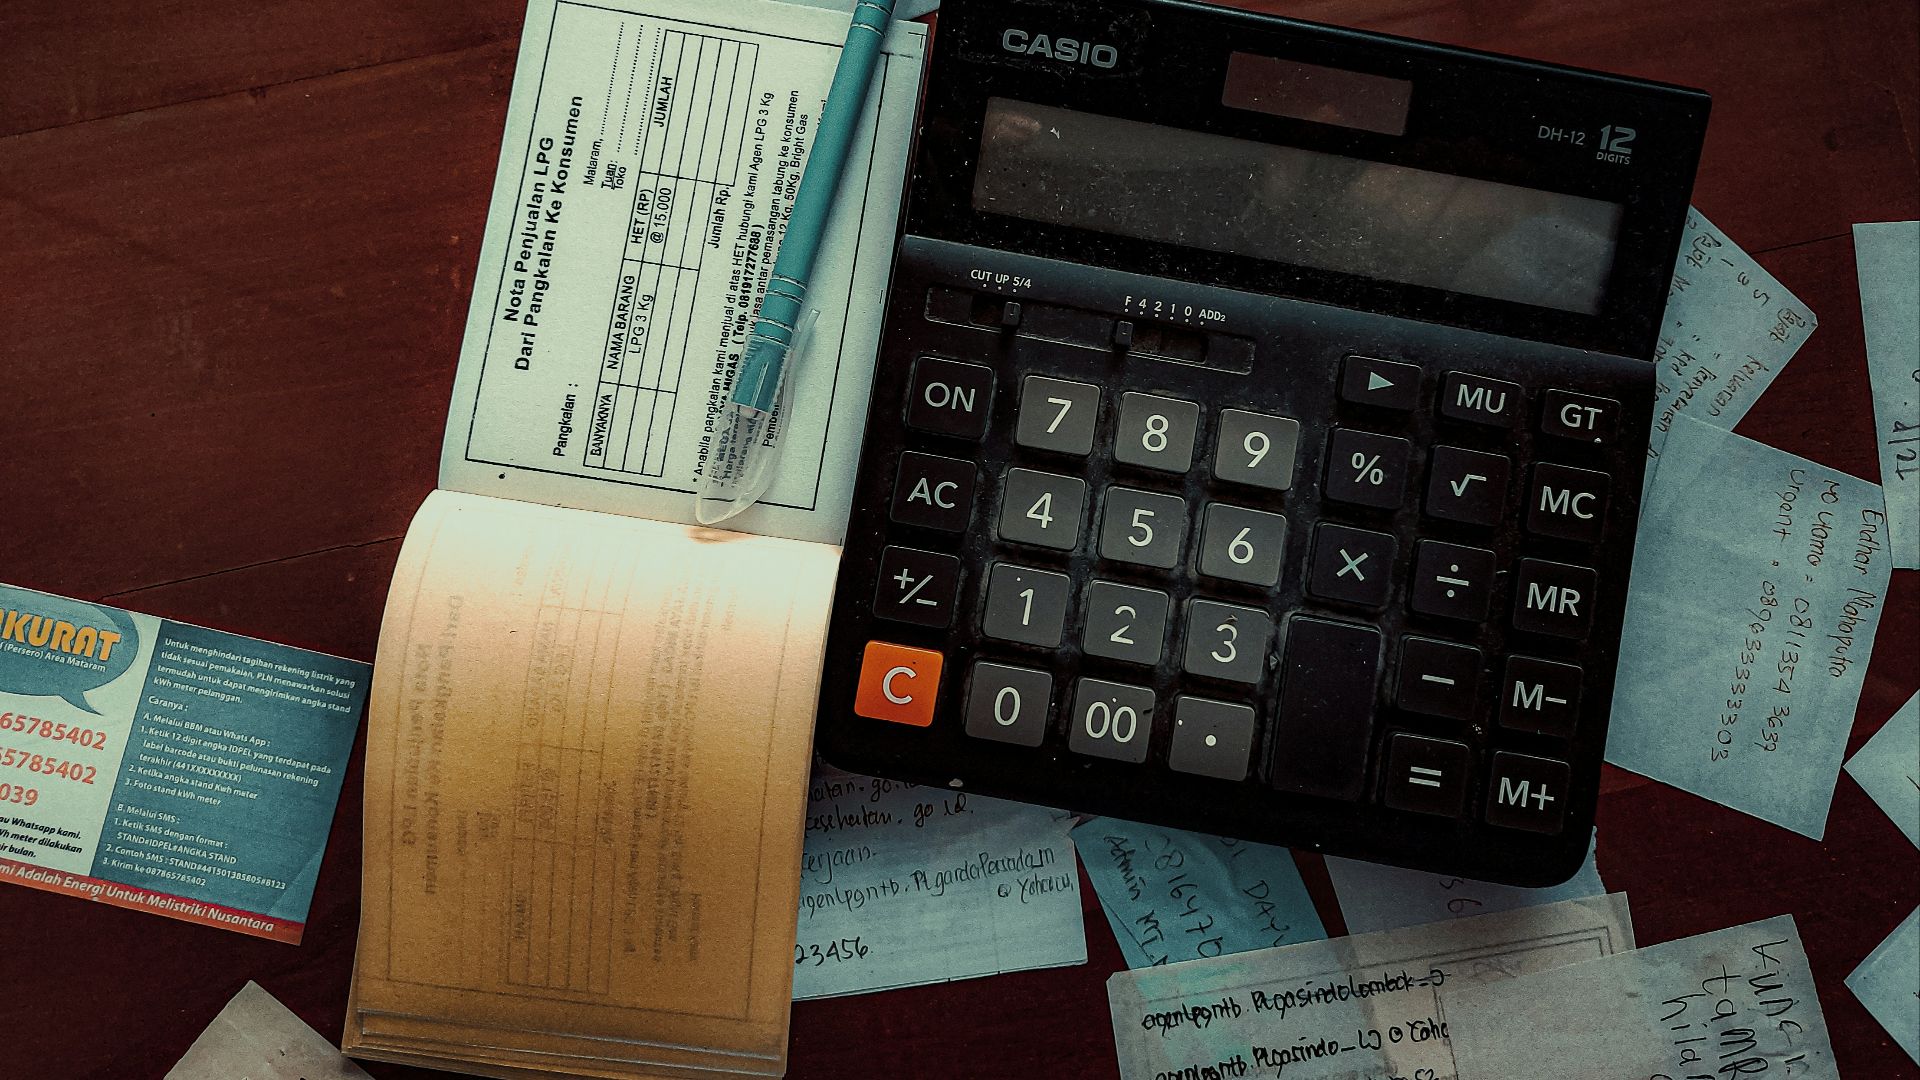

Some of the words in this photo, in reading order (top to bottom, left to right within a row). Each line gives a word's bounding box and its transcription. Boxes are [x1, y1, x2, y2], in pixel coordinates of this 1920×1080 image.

[1002, 24, 1117, 74] CASIO
[653, 76, 672, 127] JUMLAH
[759, 92, 774, 106] Kg
[780, 89, 798, 142] konsumen
[753, 118, 766, 141] LPG
[796, 113, 807, 134] Gas
[1537, 125, 1585, 145] DH-12
[1600, 124, 1636, 153] 12
[533, 137, 553, 175] LPG
[550, 96, 582, 194] Konsumen
[582, 138, 603, 185] Mataram,
[748, 143, 762, 171] Agen
[778, 144, 788, 157] ke
[789, 137, 805, 167] Bright
[1596, 152, 1631, 164] DIGITS
[743, 172, 758, 197] kami
[772, 160, 788, 195] tabung
[544, 199, 562, 223] Ke
[636, 188, 654, 215] (RP)
[653, 187, 671, 227] 15.000
[513, 182, 545, 272] Penjualan
[630, 217, 645, 244] HET
[707, 208, 725, 248] Jumlah
[735, 199, 754, 240] hubungi
[760, 197, 782, 264] pemasangan
[649, 231, 663, 243] @
[731, 242, 745, 266] HET
[522, 229, 556, 326] Pangkalan
[728, 269, 740, 290] atas
[755, 266, 768, 293] antar
[970, 269, 992, 281] CUT
[995, 273, 1009, 283] UP
[1012, 276, 1031, 290] 5/4
[502, 278, 525, 321] Nota
[614, 275, 635, 329] BARANG
[636, 290, 656, 310] Kg
[725, 288, 737, 303] di
[1124, 295, 1131, 305] F
[1138, 298, 1146, 308] 4
[1154, 300, 1161, 311] 2
[1171, 303, 1175, 313] 1
[1184, 305, 1192, 316] 0
[634, 314, 646, 322] 3
[719, 305, 734, 347] menjual
[514, 331, 535, 370] Dari
[606, 332, 624, 369] NAMA
[628, 326, 644, 353] LPG
[711, 349, 729, 375] kami
[703, 377, 724, 433] pangkalan
[924, 382, 975, 412] ON
[1456, 380, 1511, 415] MU
[552, 393, 576, 456] Pangkalan
[589, 394, 612, 456] BANYAKNYA
[1046, 397, 1071, 432] 7
[1560, 403, 1602, 429] GT
[1142, 414, 1168, 451] 8
[1243, 431, 1269, 467] 9
[1351, 452, 1383, 484] %
[906, 477, 958, 508] AC
[1540, 485, 1595, 518] MC
[1026, 492, 1052, 528] 4
[1127, 508, 1154, 546] 5
[1228, 527, 1253, 563] 6
[1019, 588, 1033, 625] 1
[1526, 582, 1580, 616] MR
[1110, 605, 1135, 644] 2
[4, 643, 43, 659] (Persero)
[44, 652, 64, 663] Area
[66, 656, 105, 672] Mataram
[1211, 624, 1237, 662] 3
[161, 651, 182, 662] tidak
[256, 672, 273, 682] PLN
[273, 677, 325, 693] menawarkan
[326, 689, 349, 698] solusi
[164, 638, 189, 649] Untuk
[190, 645, 241, 661] menghindari
[242, 656, 273, 668] tagihan
[274, 664, 309, 678] rekening
[310, 670, 333, 681] listrik
[334, 678, 355, 688] yang
[153, 676, 171, 686] kWh
[172, 682, 197, 692] meter
[157, 664, 196, 679] termudah
[197, 674, 221, 684] untuk
[222, 678, 246, 690] dapat
[246, 685, 300, 702] mengirimkan
[301, 697, 326, 707] angka
[328, 703, 350, 712] stand
[882, 666, 916, 704] C
[148, 695, 183, 710] Caranya
[994, 686, 1020, 725] 0
[1085, 702, 1136, 742] 00
[132, 779, 152, 789] Foto
[152, 785, 176, 795] stand
[177, 788, 195, 799] kWh
[196, 795, 221, 805] meter
[1498, 776, 1554, 810] M+
[10, 833, 37, 843] meter
[37, 837, 82, 853] dilakukan
[11, 817, 55, 835] Whatsapp
[111, 858, 132, 870] Kirim
[14, 866, 61, 885] Adalah
[62, 876, 106, 896] Energi
[106, 885, 145, 903] Untuk
[145, 894, 207, 916] Melistriki
[207, 907, 273, 931] Nusantara
